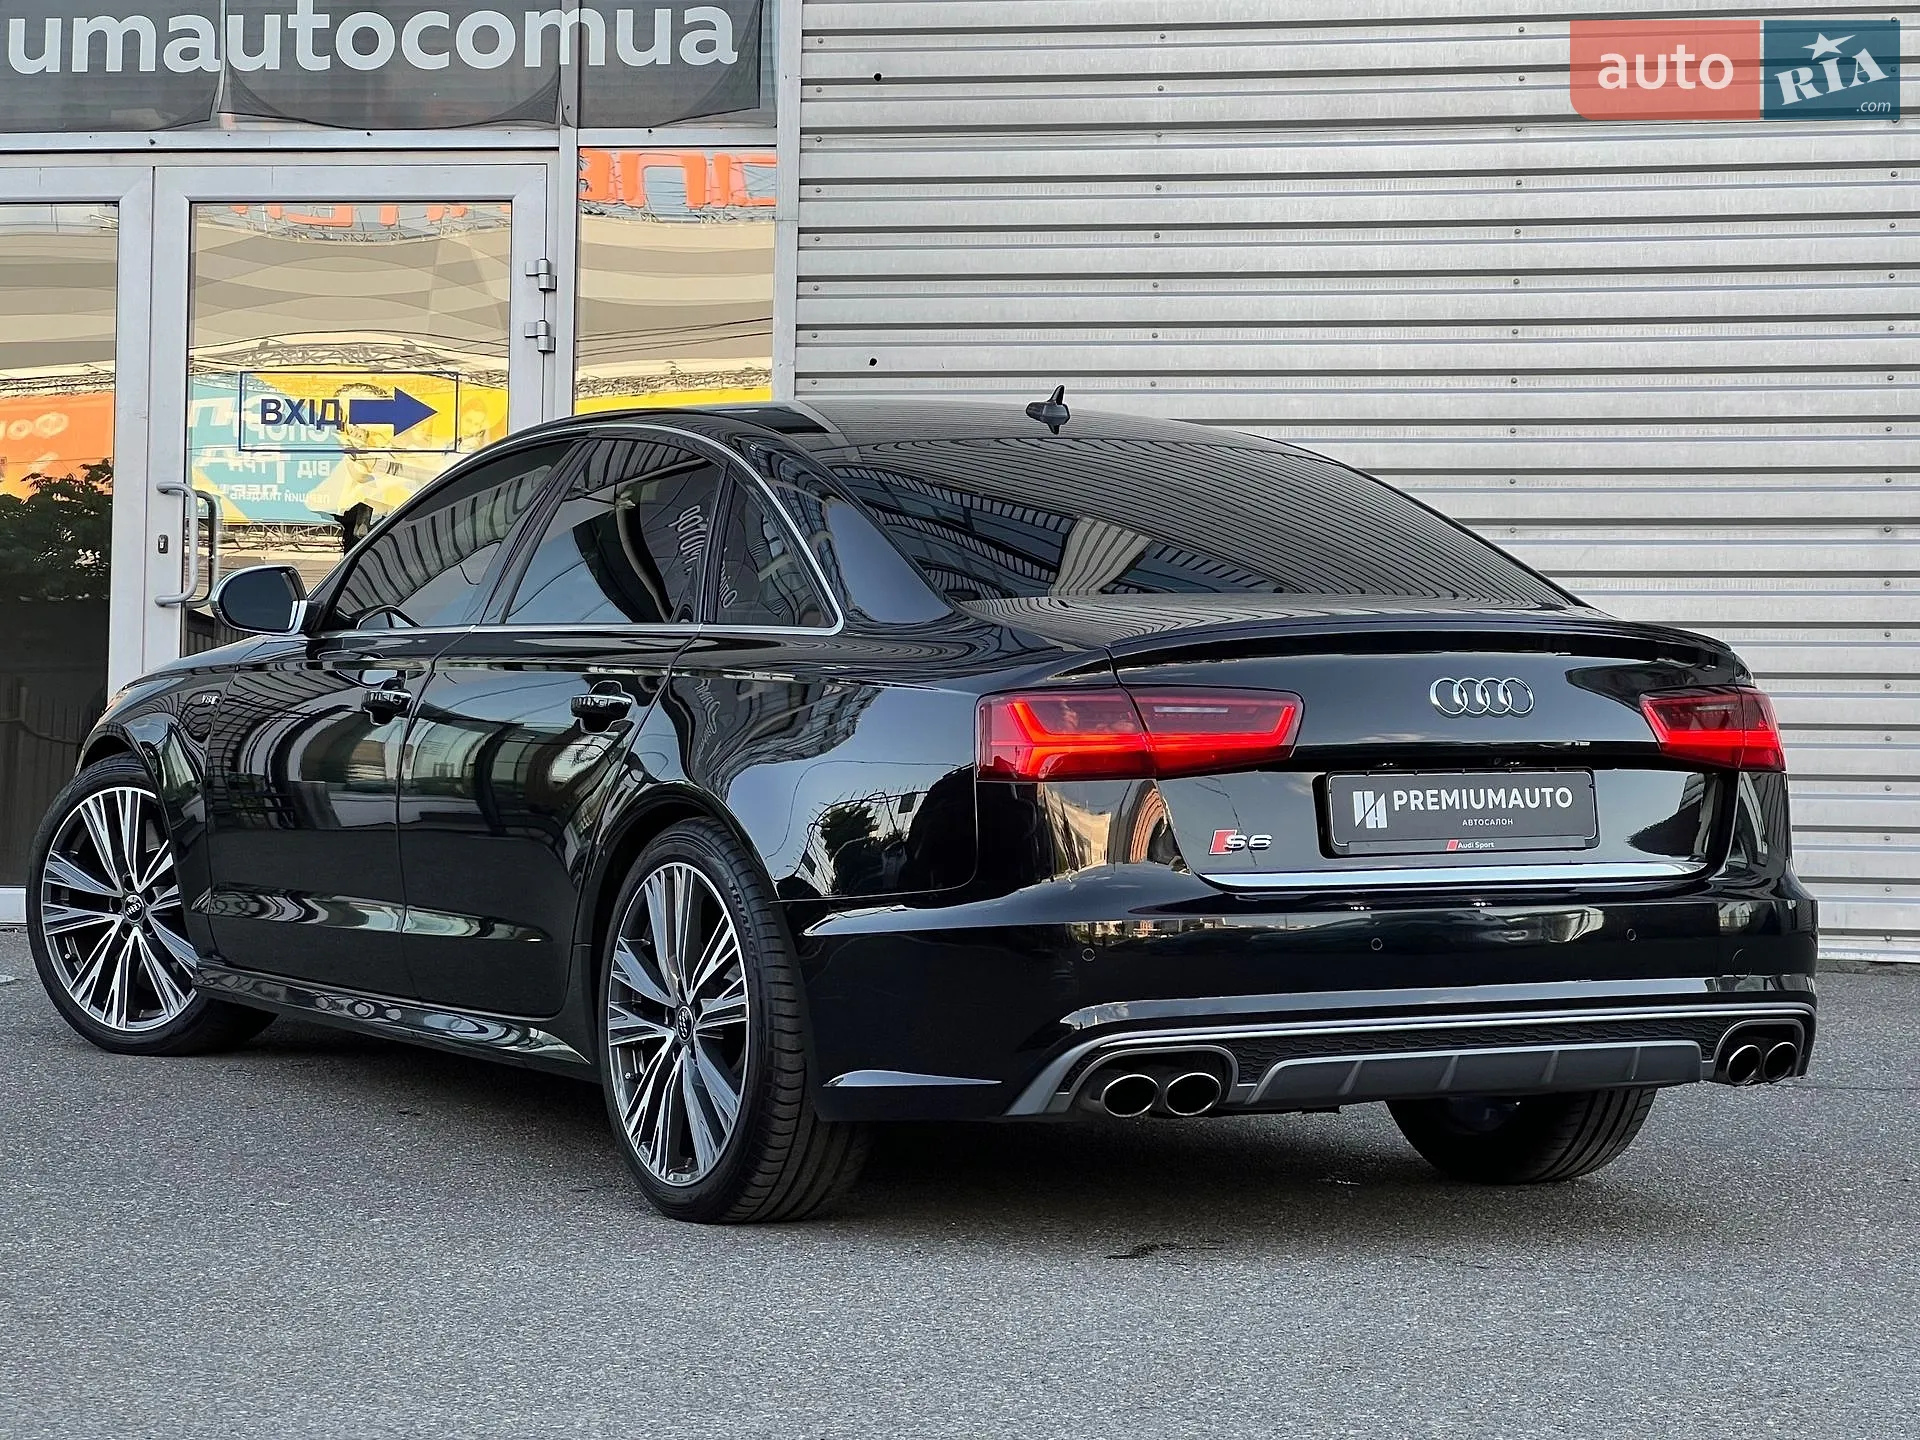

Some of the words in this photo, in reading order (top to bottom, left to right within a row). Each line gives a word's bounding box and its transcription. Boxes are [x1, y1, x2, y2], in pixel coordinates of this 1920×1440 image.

[8, 0, 738, 75] umautocomua
[260, 398, 344, 431] ВХІД
[1393, 787, 1573, 811] PREMIUMAUTO
[1462, 818, 1514, 827] АВТОСАЛОН
[1223, 834, 1273, 851] S6
[1458, 840, 1474, 849] Audi
[1475, 840, 1495, 850] Sport
